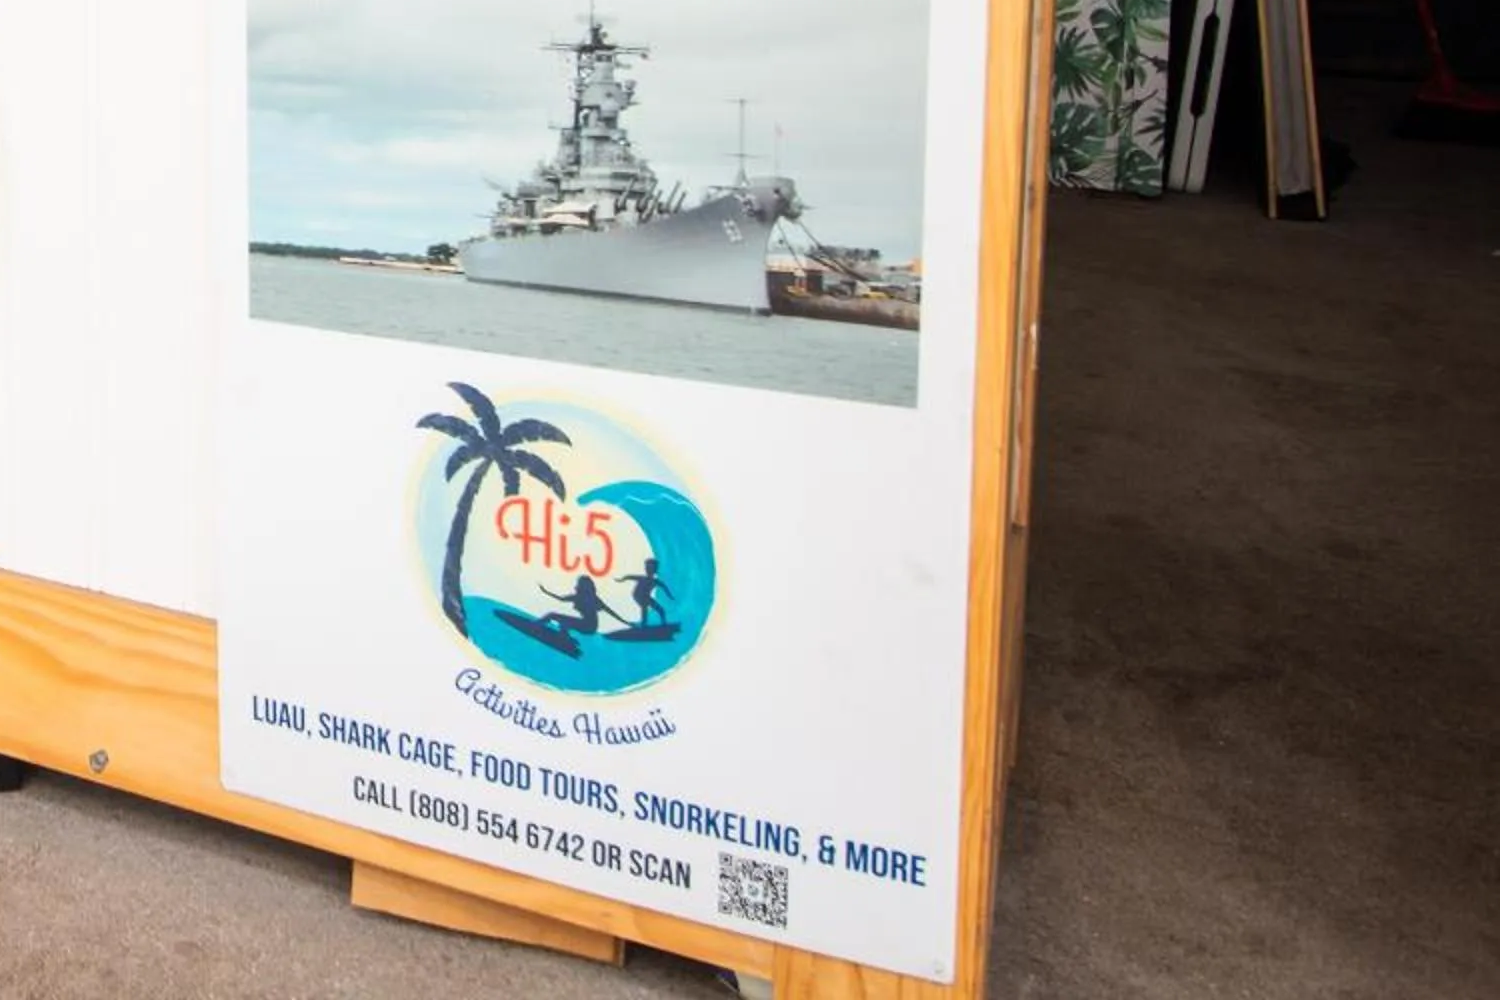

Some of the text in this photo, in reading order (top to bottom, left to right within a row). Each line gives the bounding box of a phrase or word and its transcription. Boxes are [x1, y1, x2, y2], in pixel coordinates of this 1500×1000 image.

[494, 497, 615, 578] Hi5
[454, 667, 677, 745] Activities Hawaii
[251, 694, 928, 888] LUAU, SHARK CAGE, FOOD TOURS, SNORKELING, & MORE
[352, 775, 693, 890] CALL (808) 554 6742 OR SCAN
